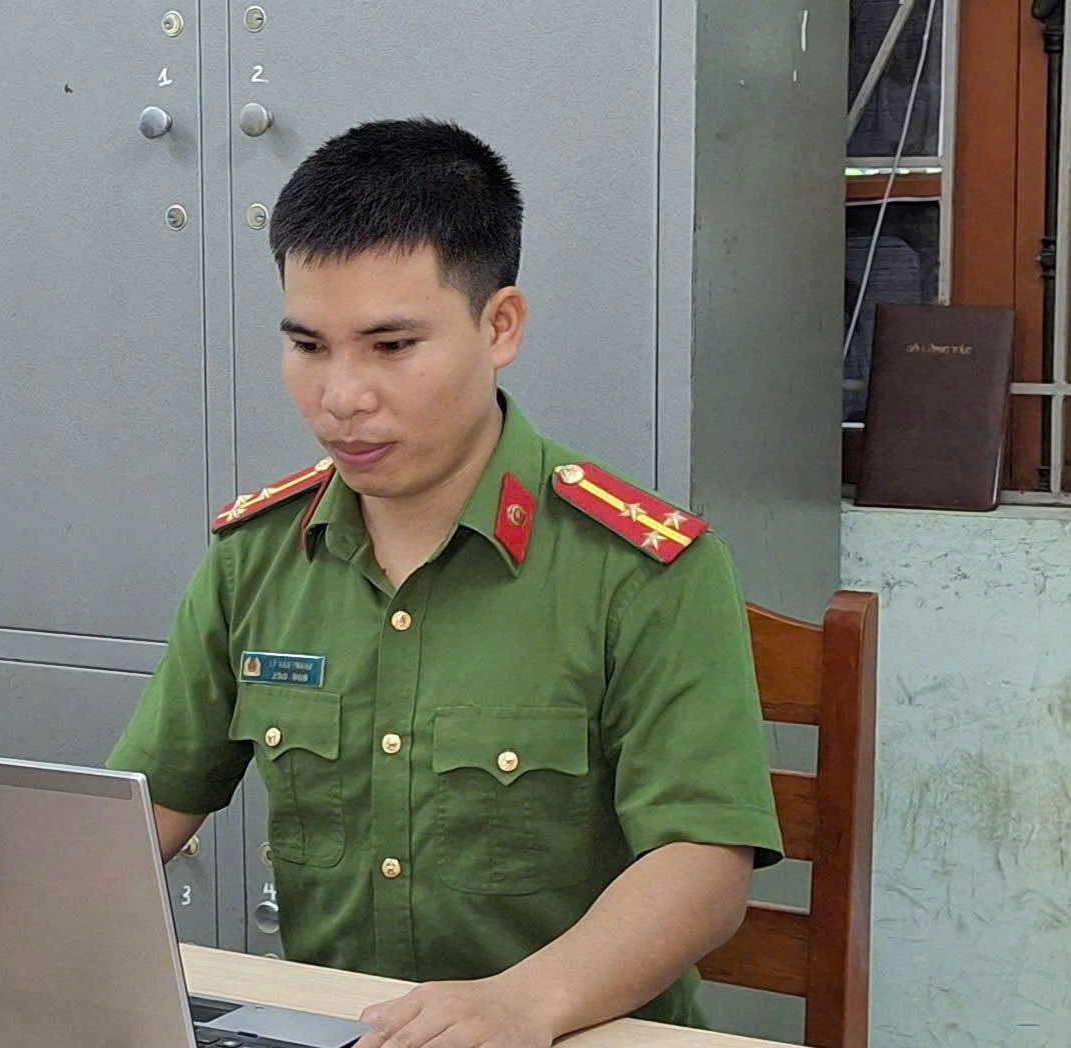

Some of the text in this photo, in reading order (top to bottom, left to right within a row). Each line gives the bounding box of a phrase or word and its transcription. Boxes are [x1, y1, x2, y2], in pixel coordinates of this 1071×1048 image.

[157, 67, 173, 86] 1
[251, 65, 269, 83] 2
[180, 885, 191, 905] 3
[263, 882, 276, 901] 4
